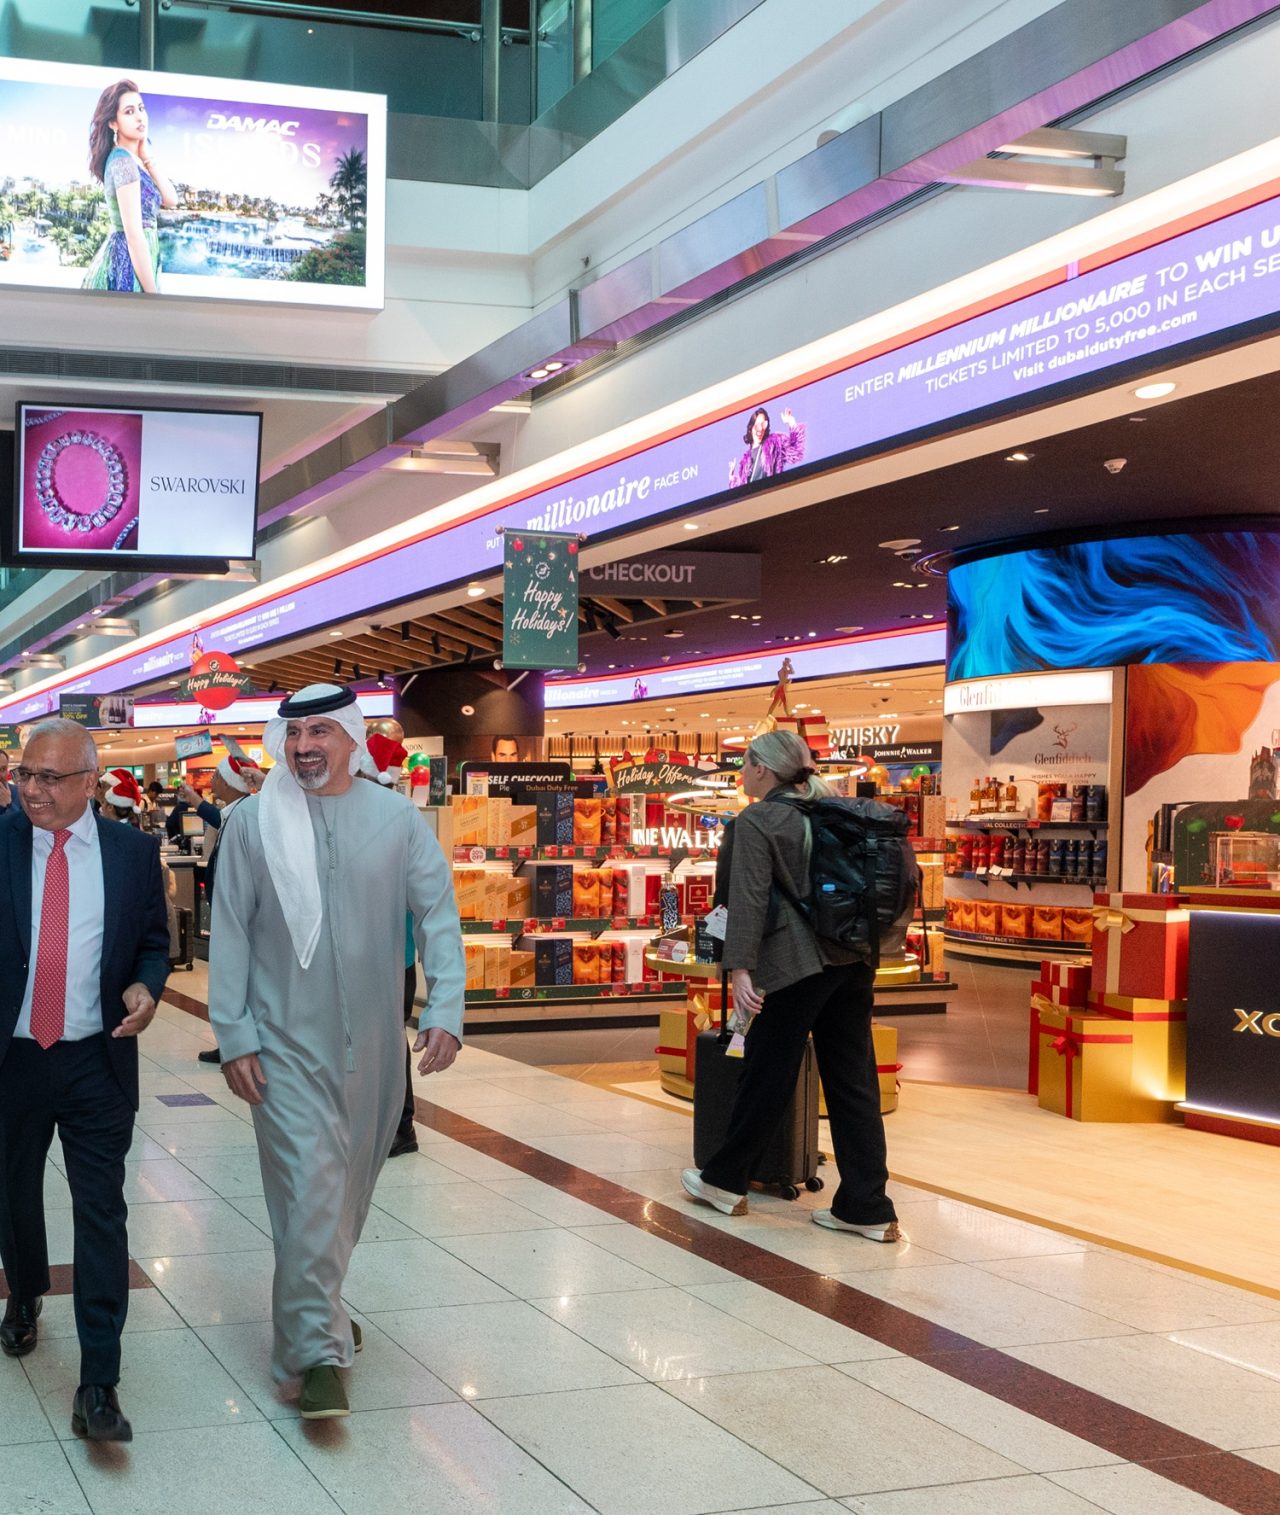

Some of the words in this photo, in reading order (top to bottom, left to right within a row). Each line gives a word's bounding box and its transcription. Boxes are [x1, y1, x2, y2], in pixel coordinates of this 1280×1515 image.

[207, 114, 300, 136] DAMAC
[844, 371, 896, 403] ENTER
[897, 327, 1008, 384] MILLENNIUM
[1008, 274, 1148, 342] MILLIONAIRE
[1155, 261, 1189, 288] TO
[1194, 235, 1253, 274] WIN
[925, 359, 988, 394] TICKETS
[992, 334, 1060, 371] LIMITED
[1064, 323, 1091, 344] TO
[1095, 301, 1152, 334] 5,000
[1156, 290, 1179, 313] IN
[1184, 265, 1247, 304] EACH
[1012, 360, 1045, 382] Visit
[1047, 309, 1199, 371] dubaidutyfree.com
[150, 475, 246, 495] SWAROVSKI
[526, 475, 652, 531] millionaire
[654, 474, 681, 491] FACE
[681, 464, 700, 481] ON
[486, 538, 501, 551] PUT
[589, 562, 697, 584] CHECKOUT
[522, 579, 564, 612] Happy
[510, 607, 576, 640] Holidays!
[187, 677, 211, 692] Happy
[212, 672, 250, 688] Holidays!
[827, 723, 901, 748] WHISKY
[874, 749, 901, 759] JOHNNIE
[906, 747, 933, 757] WALKER
[1034, 752, 1093, 765] Glenfiddich
[488, 775, 509, 785] SELF
[616, 765, 655, 788] Holiday
